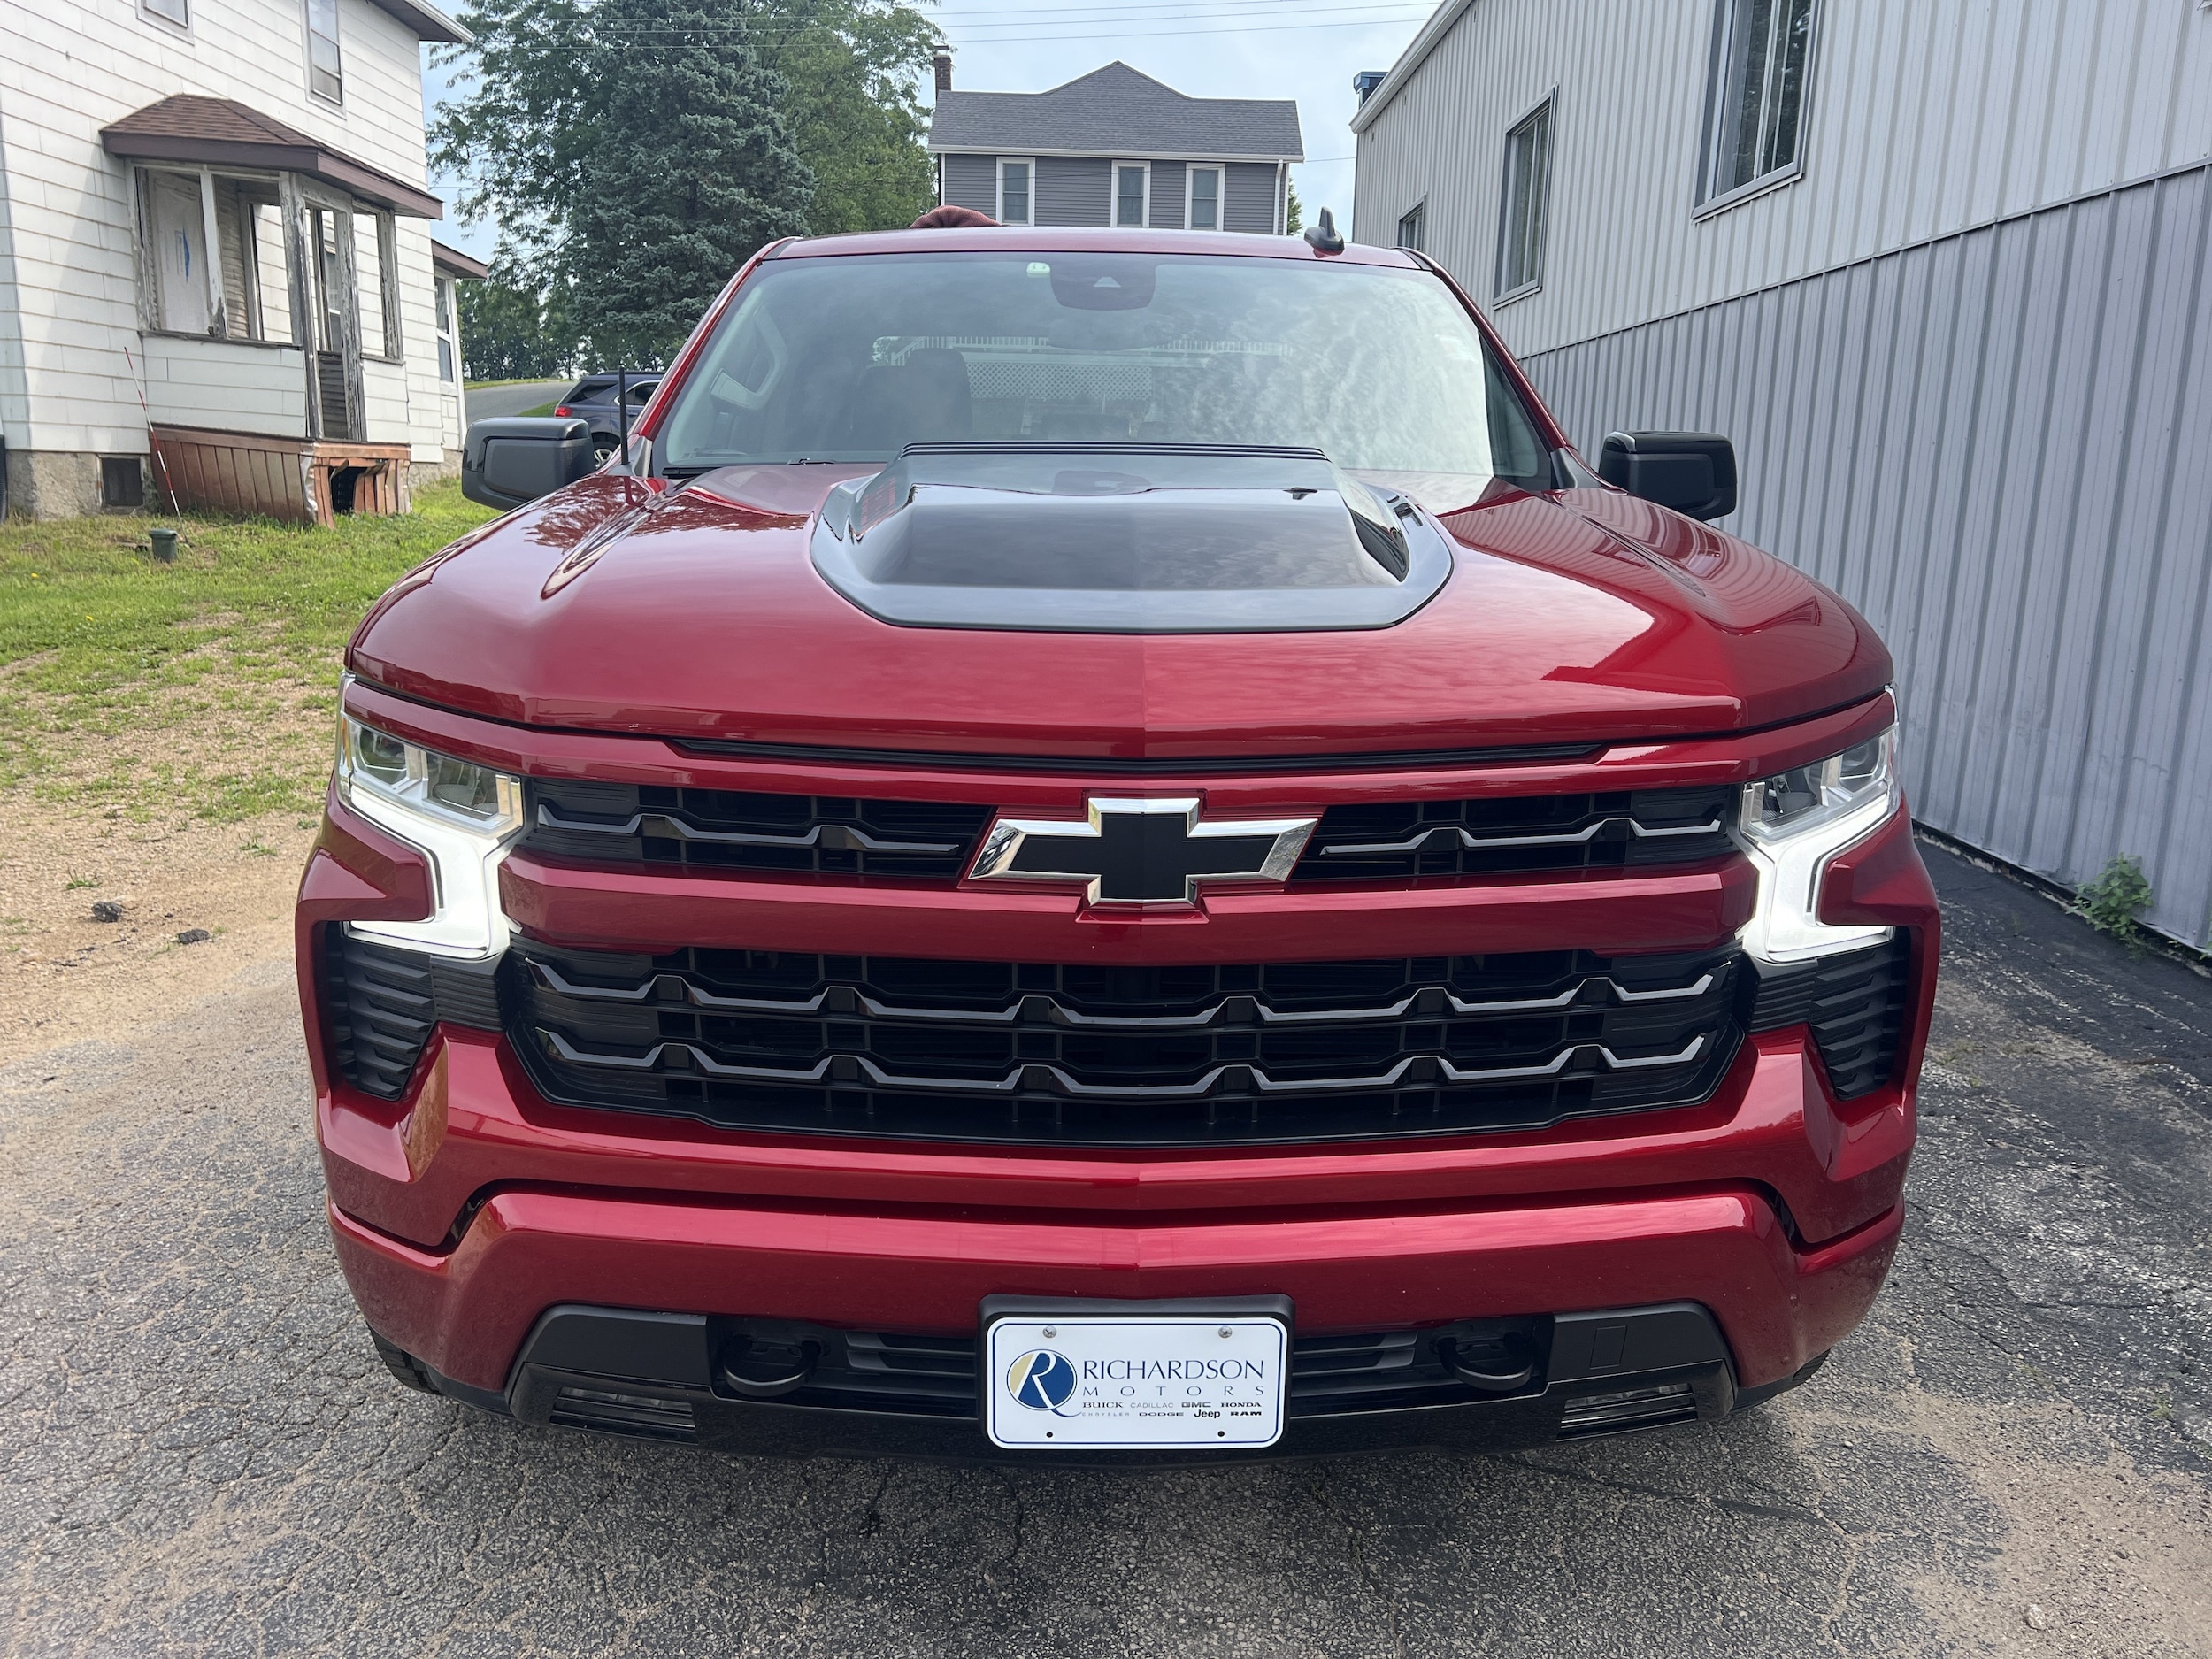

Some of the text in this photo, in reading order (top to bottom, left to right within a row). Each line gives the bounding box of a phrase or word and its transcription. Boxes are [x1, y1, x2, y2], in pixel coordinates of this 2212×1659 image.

[1083, 1359, 1264, 1380] RICHARDSON
[1082, 1385, 1264, 1397] MOTORS
[1194, 1409, 1221, 1420] Jeep
